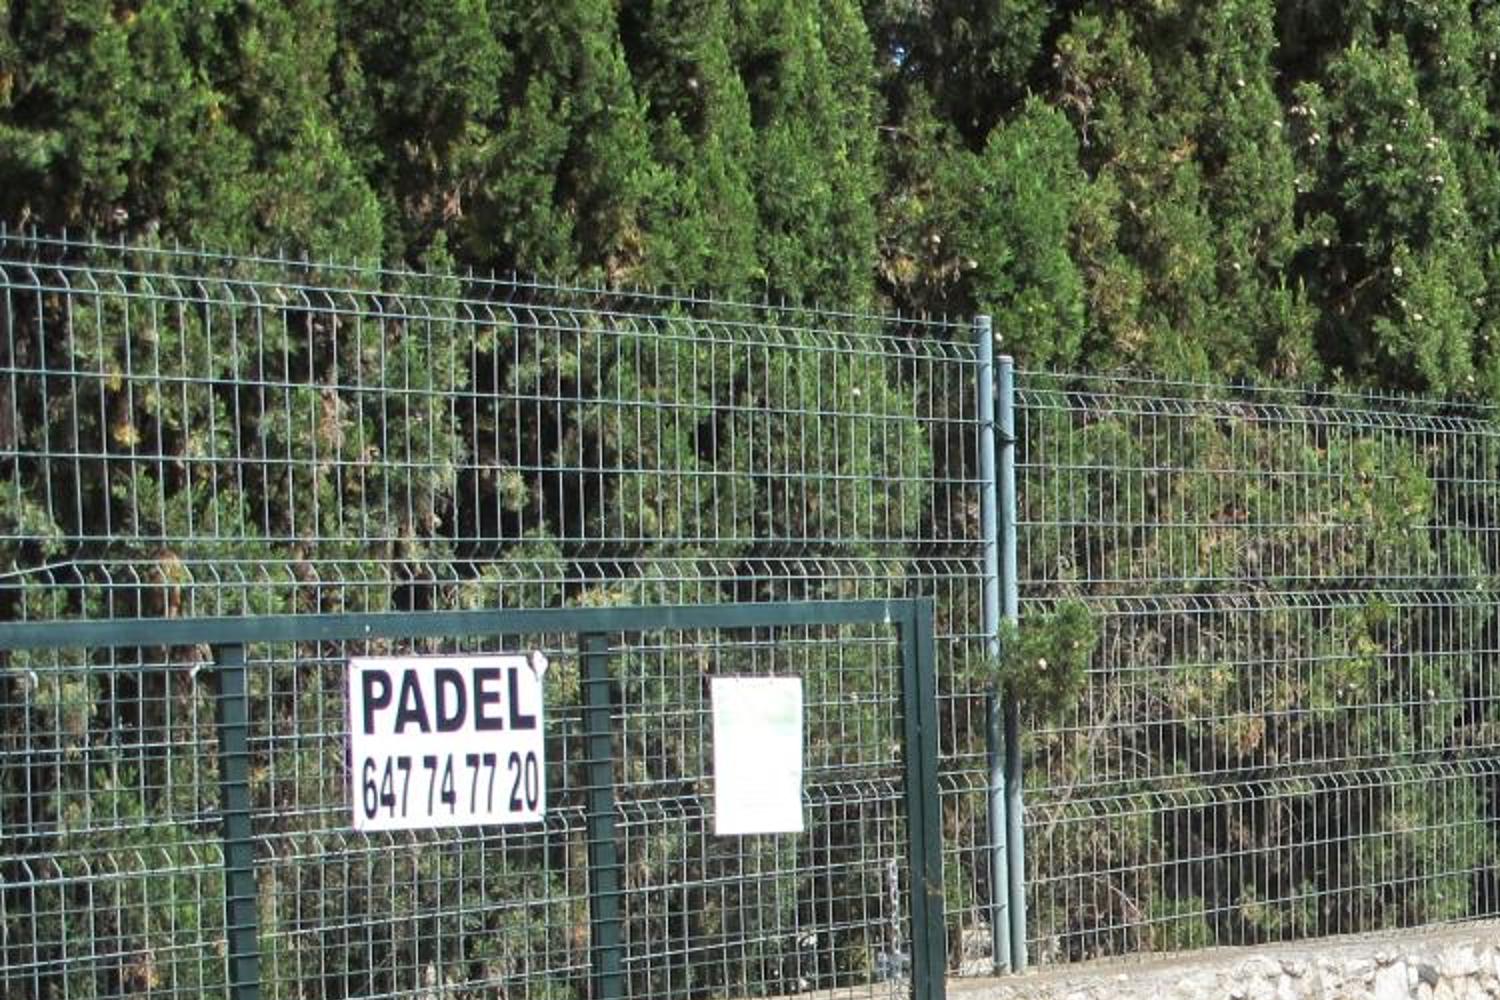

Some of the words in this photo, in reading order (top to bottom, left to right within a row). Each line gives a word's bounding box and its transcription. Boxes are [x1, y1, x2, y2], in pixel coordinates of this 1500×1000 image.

[361, 667, 536, 735] PADEL
[362, 755, 413, 819] 647
[423, 753, 457, 816] 74
[465, 752, 497, 814] 77
[508, 751, 539, 812] 20
